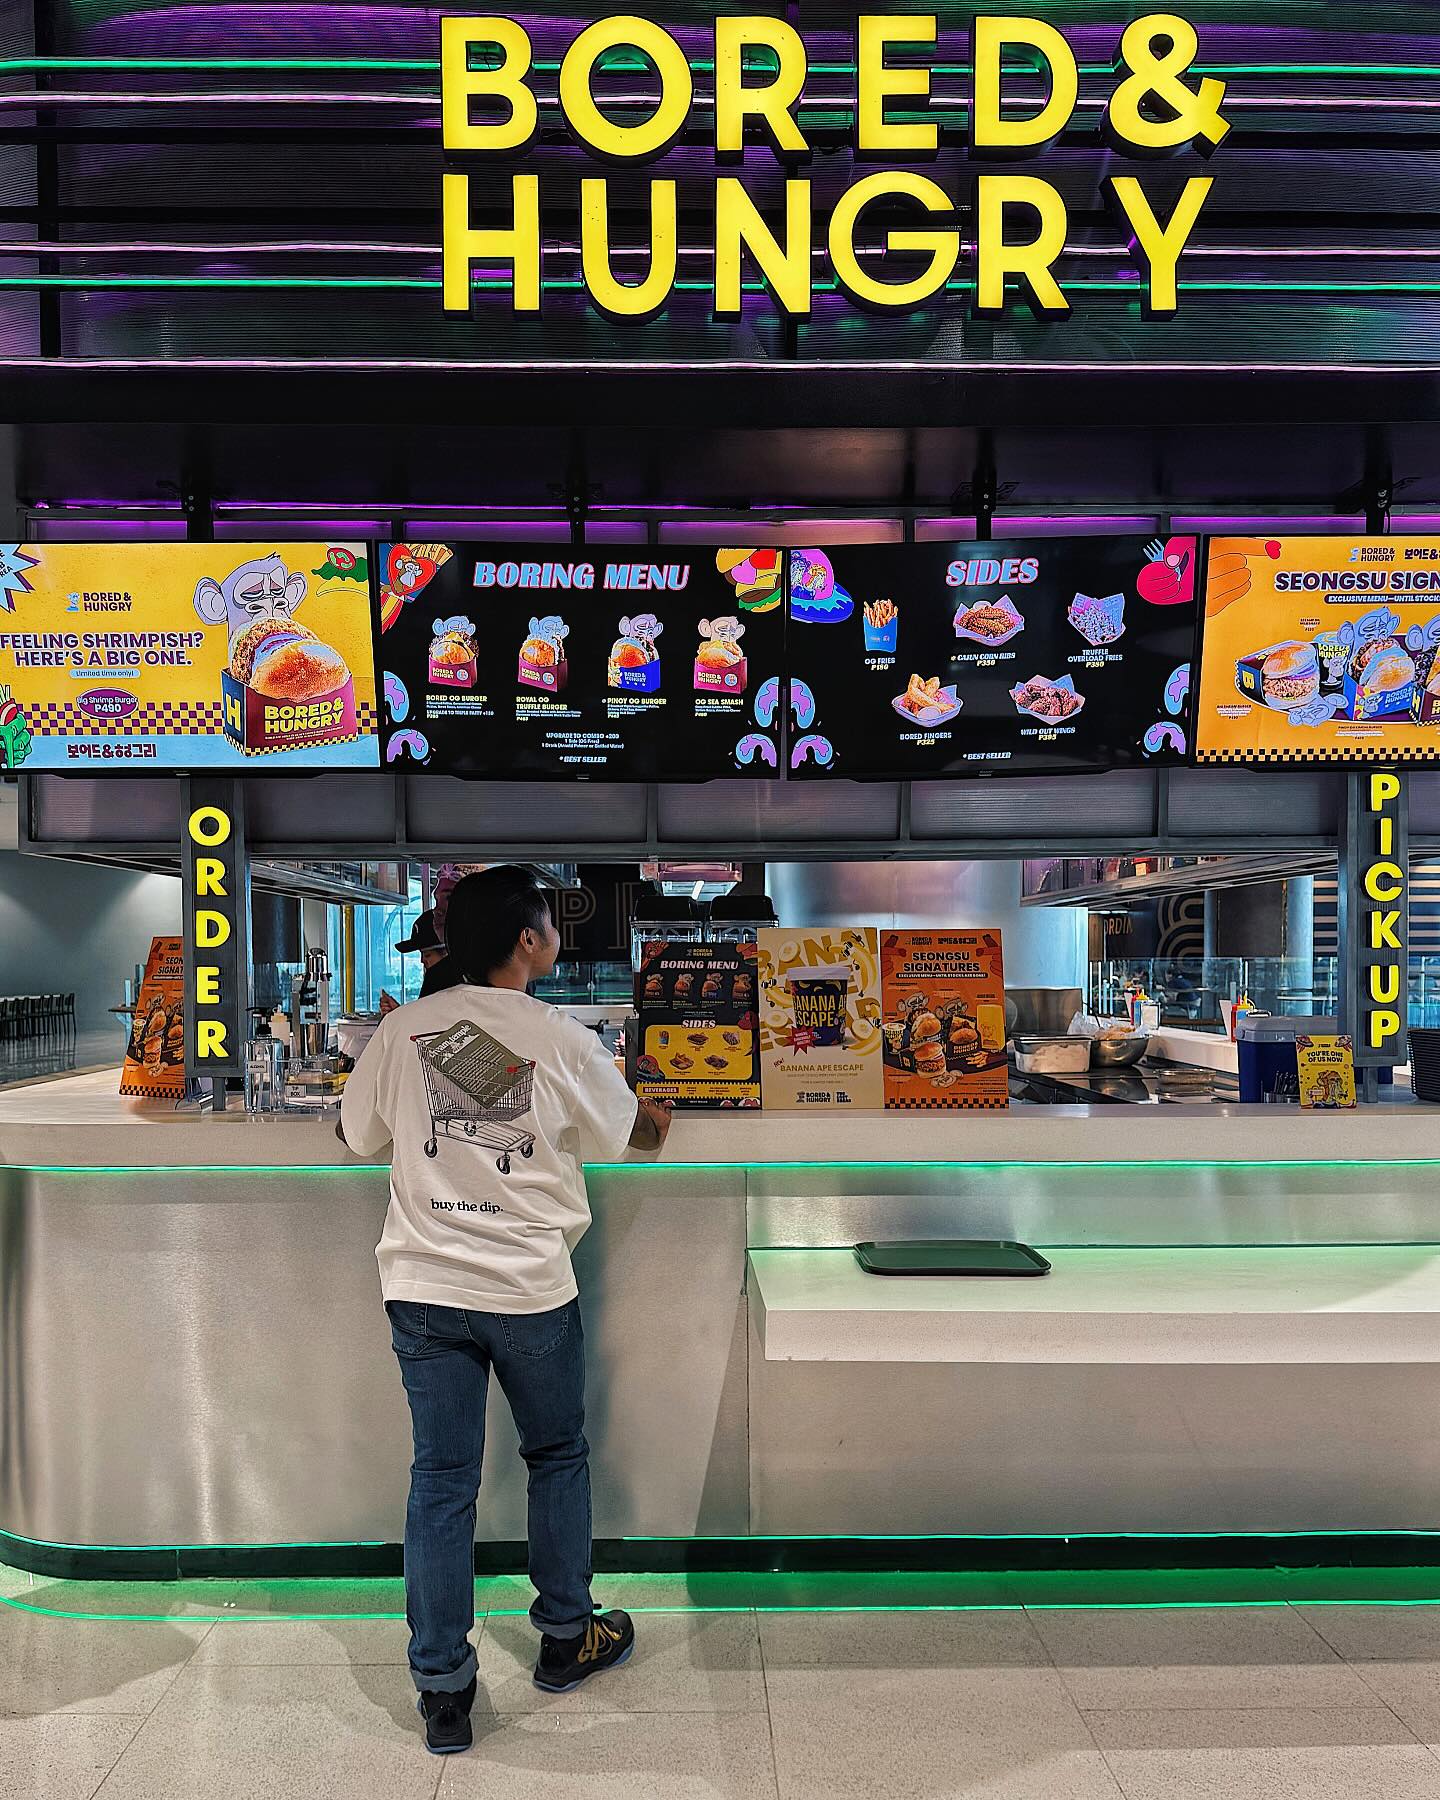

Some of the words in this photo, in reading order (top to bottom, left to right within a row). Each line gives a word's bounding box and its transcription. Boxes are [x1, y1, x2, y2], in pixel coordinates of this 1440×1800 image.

[442, 171, 1214, 315] HUNGRY
[473, 562, 595, 590] BORING
[603, 564, 690, 590] MENU
[946, 558, 1039, 586] SIDES
[1275, 572, 1386, 590] SEONGSU
[83, 592, 122, 602] BORED
[124, 592, 132, 602] &
[84, 602, 132, 612] HUNGRY
[0, 633, 78, 649] FEELING
[82, 632, 204, 648] SHRIMPISH?
[15, 651, 84, 666] HERE'S
[88, 652, 103, 666] A
[106, 651, 141, 666] BIG
[144, 650, 192, 666] ONE.
[89, 696, 114, 705] Shrimp
[226, 693, 240, 732] H
[265, 710, 344, 734] HUNGRY
[188, 806, 231, 1058] ORDER
[912, 952, 970, 960] SEONGSU
[660, 960, 705, 969] BORING
[706, 961, 739, 970] MENU
[904, 962, 980, 972] SIGNATURES
[682, 1020, 716, 1028] SIDES
[430, 1198, 455, 1212] buy
[457, 1200, 478, 1212] the
[480, 1201, 504, 1214] dip.
